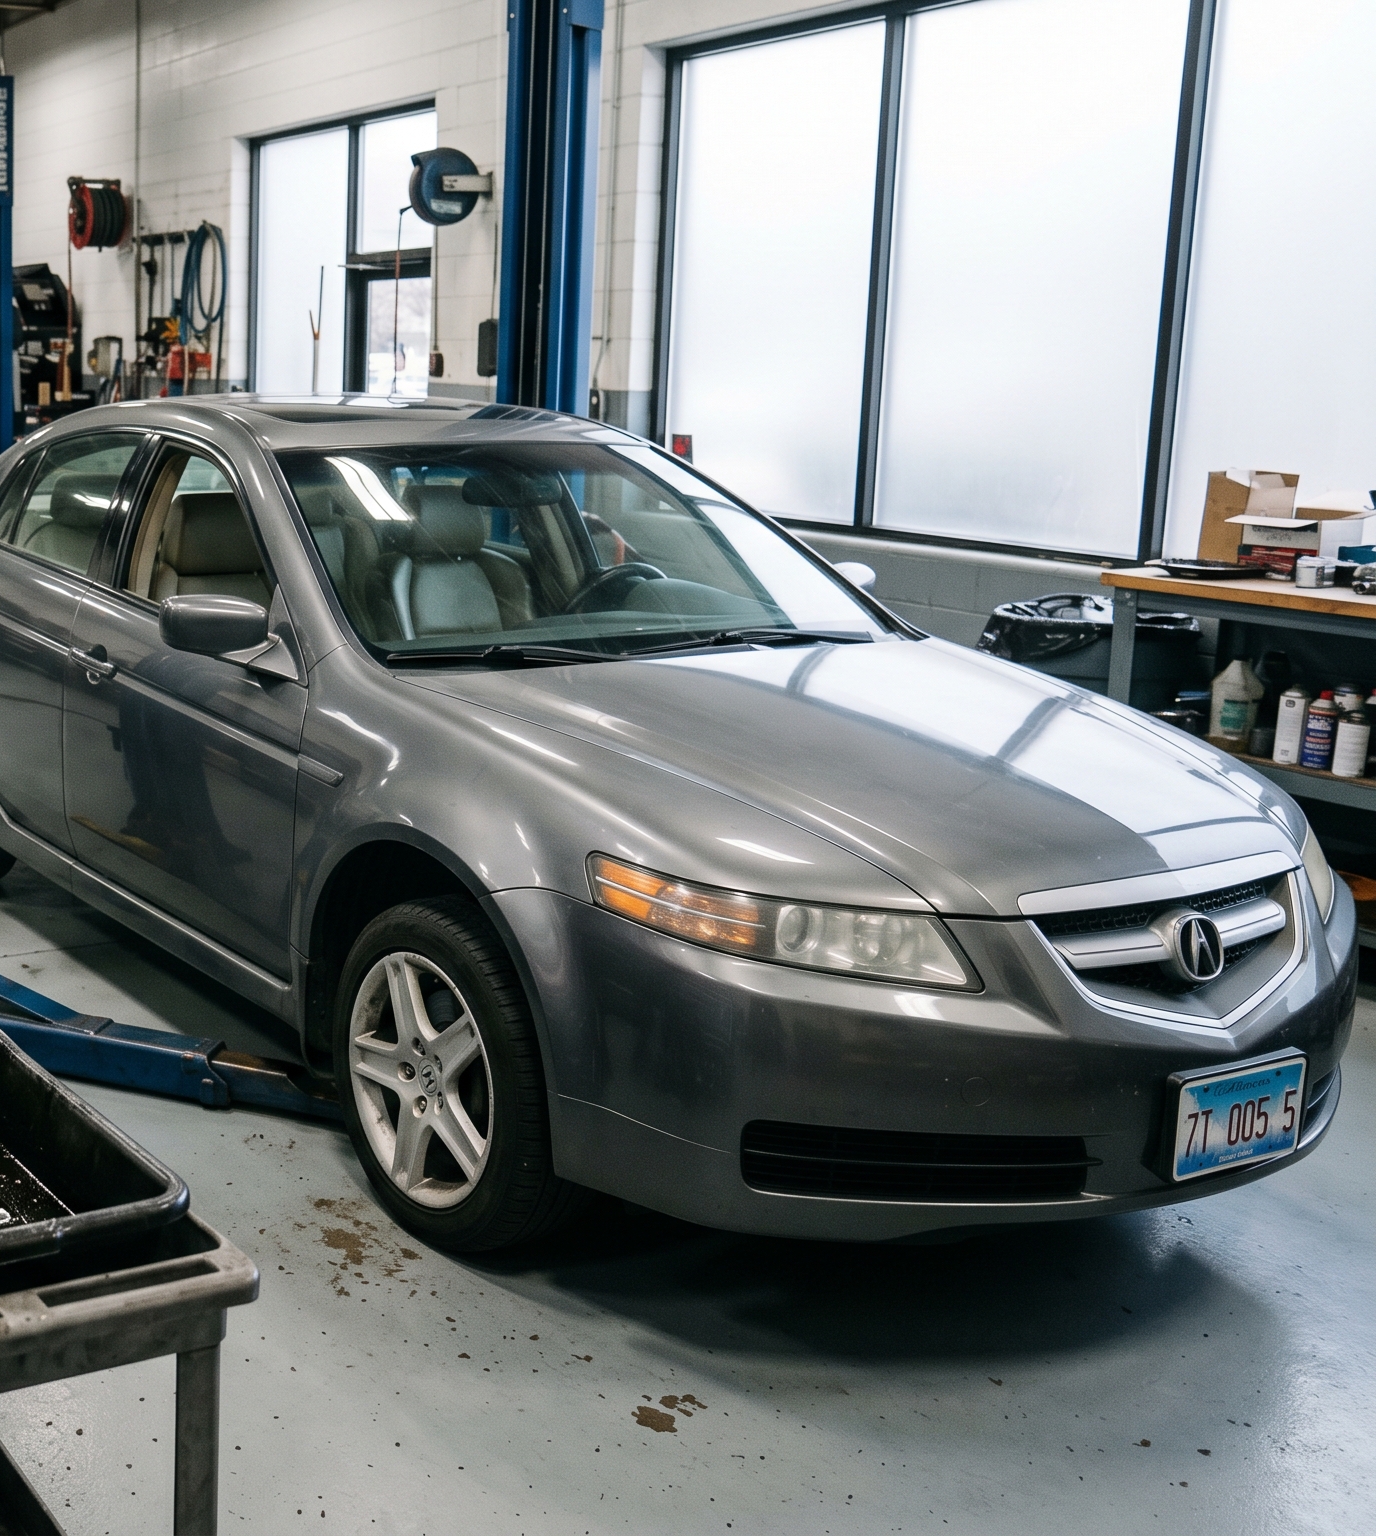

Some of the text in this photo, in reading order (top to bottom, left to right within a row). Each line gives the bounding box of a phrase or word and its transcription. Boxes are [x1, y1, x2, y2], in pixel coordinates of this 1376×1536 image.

[1185, 1089, 1297, 1158] 7T 005 5
